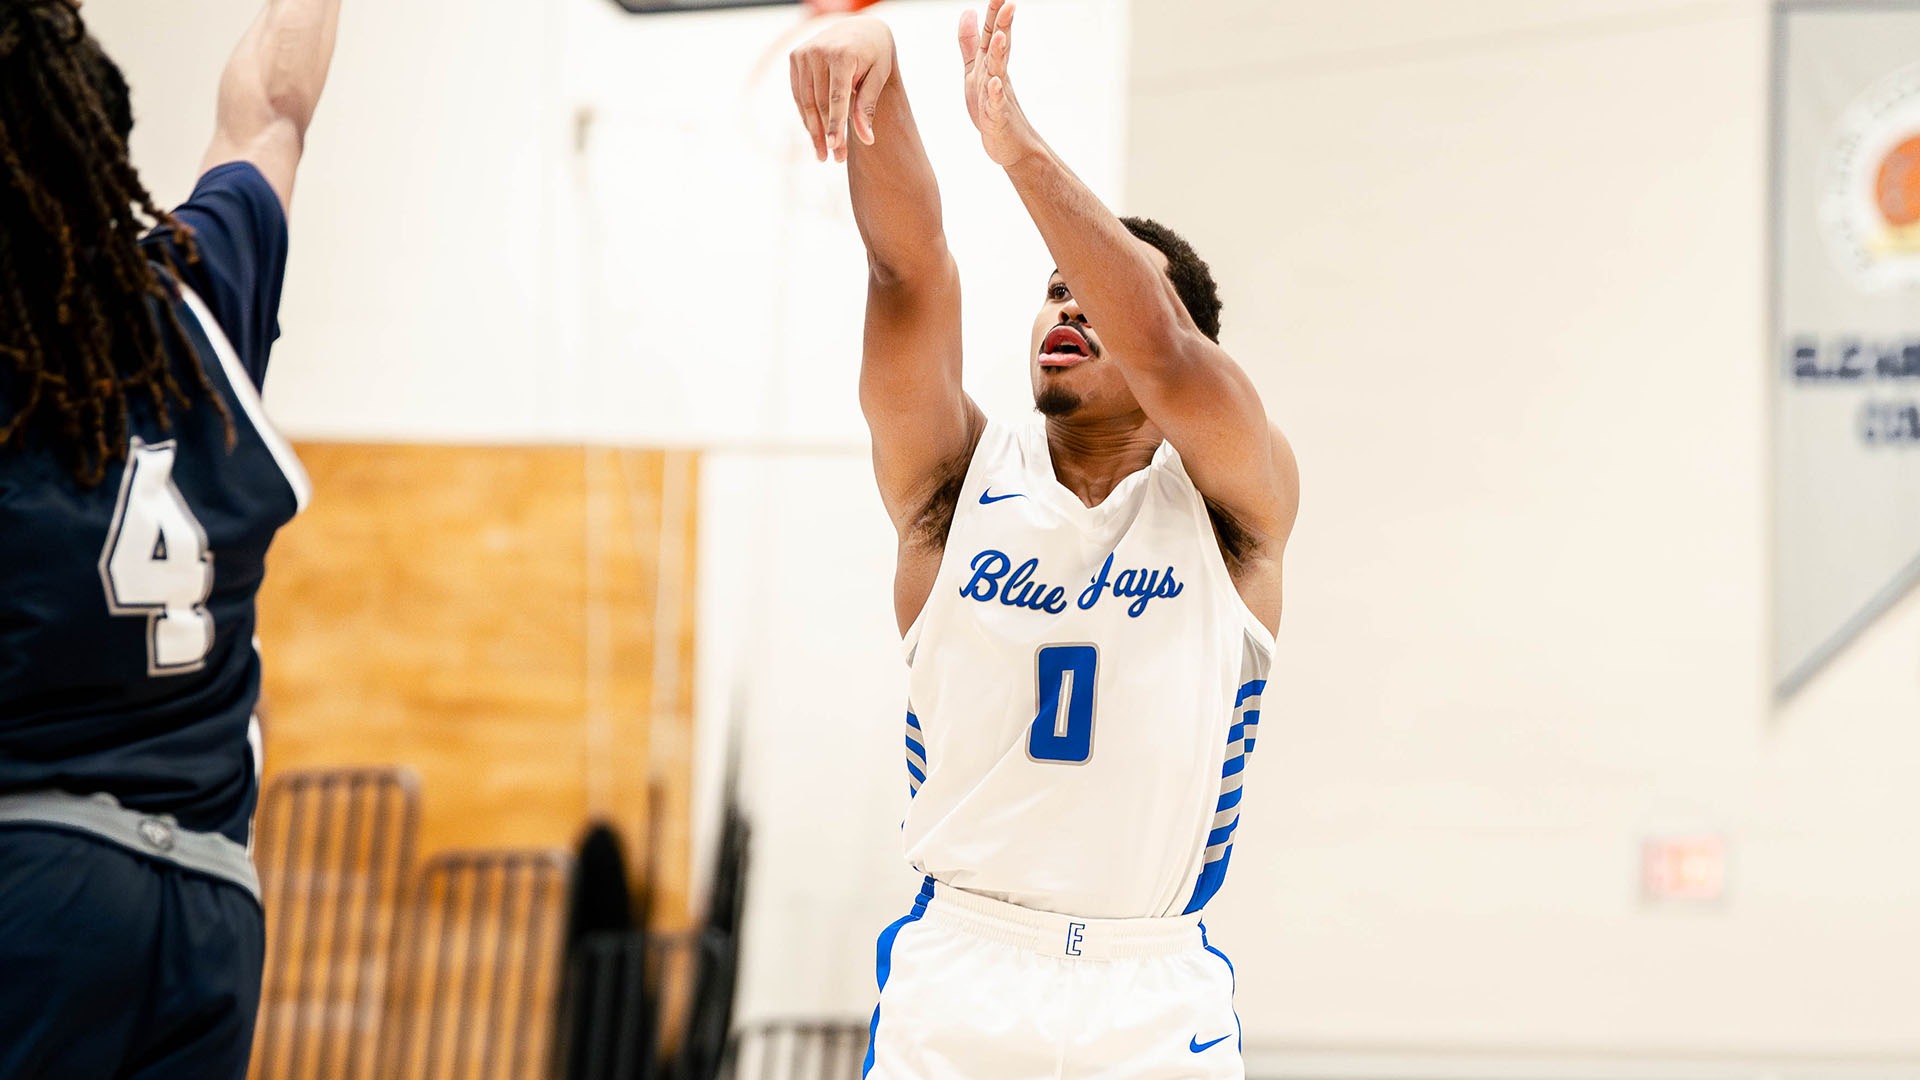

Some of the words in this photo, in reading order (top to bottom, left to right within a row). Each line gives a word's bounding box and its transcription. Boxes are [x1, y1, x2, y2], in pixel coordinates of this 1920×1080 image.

[99, 436, 215, 676] 4
[959, 550, 1067, 614] Blue
[1077, 551, 1184, 618] Jays
[1025, 642, 1100, 766] 0
[1065, 922, 1086, 956] E
